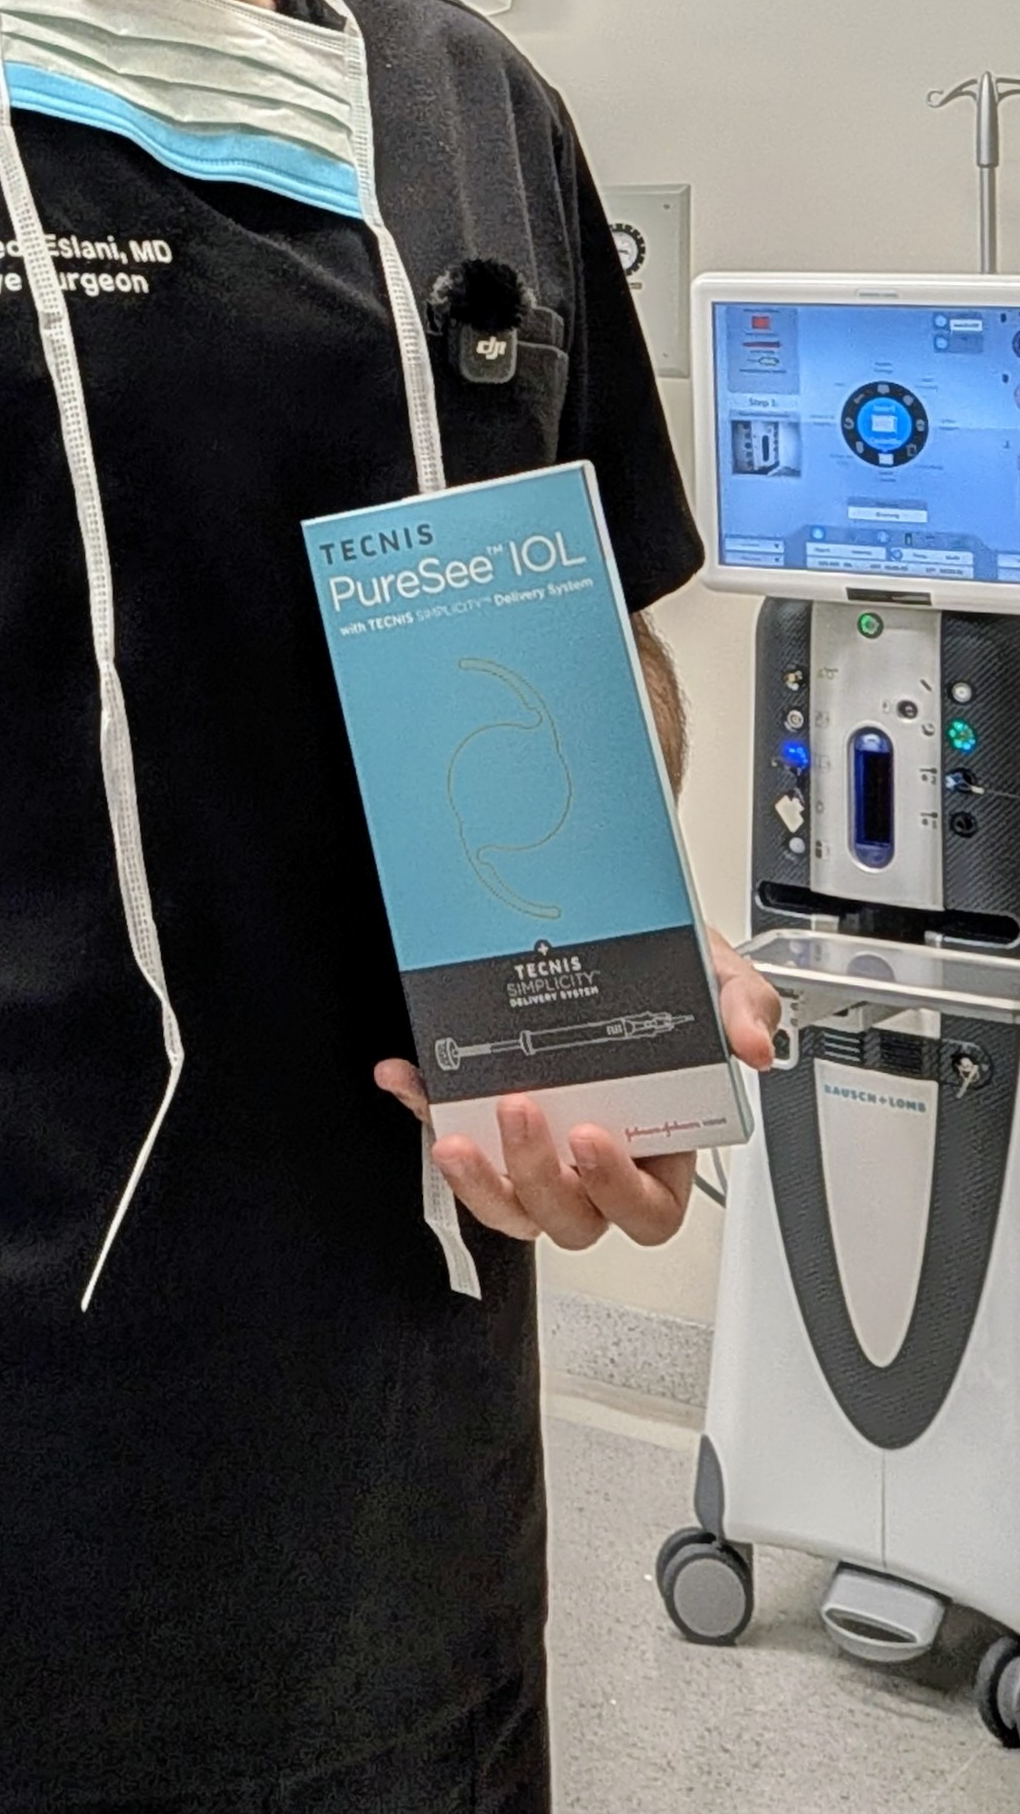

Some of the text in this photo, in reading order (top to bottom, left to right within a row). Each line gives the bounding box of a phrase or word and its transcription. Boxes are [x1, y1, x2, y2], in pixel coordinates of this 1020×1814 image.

[128, 239, 173, 264] MD
[58, 271, 150, 297] urgeon
[320, 523, 434, 565] TECNIS
[508, 531, 587, 576] IOL
[340, 622, 367, 637] with
[368, 611, 415, 631] TECNIS
[493, 588, 545, 607] Delivery
[547, 577, 594, 595] System
[514, 956, 582, 980] TECNIS
[509, 985, 599, 1008] DELIVERY SYSTEM
